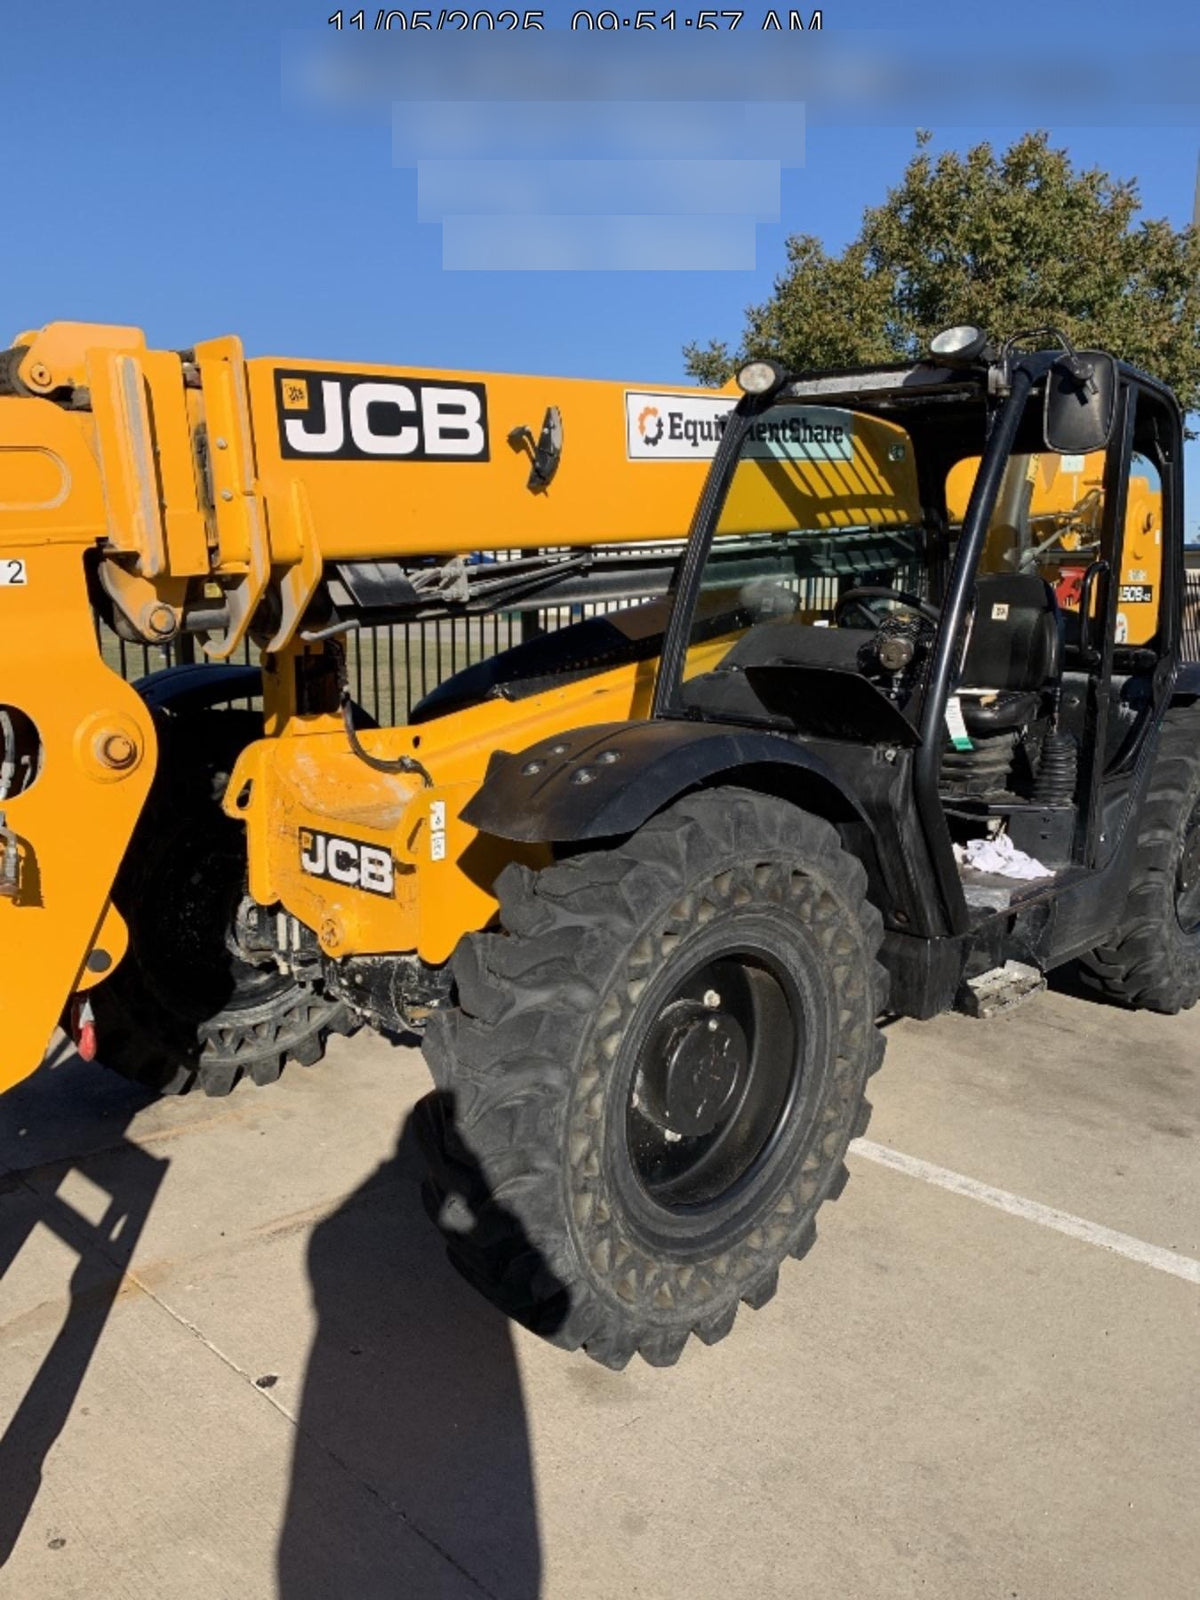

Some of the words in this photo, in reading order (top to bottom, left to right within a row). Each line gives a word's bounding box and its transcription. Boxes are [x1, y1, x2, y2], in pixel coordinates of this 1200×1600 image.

[284, 380, 485, 455] JCB
[668, 411, 844, 447] EquientShare
[301, 834, 394, 894] JCB
